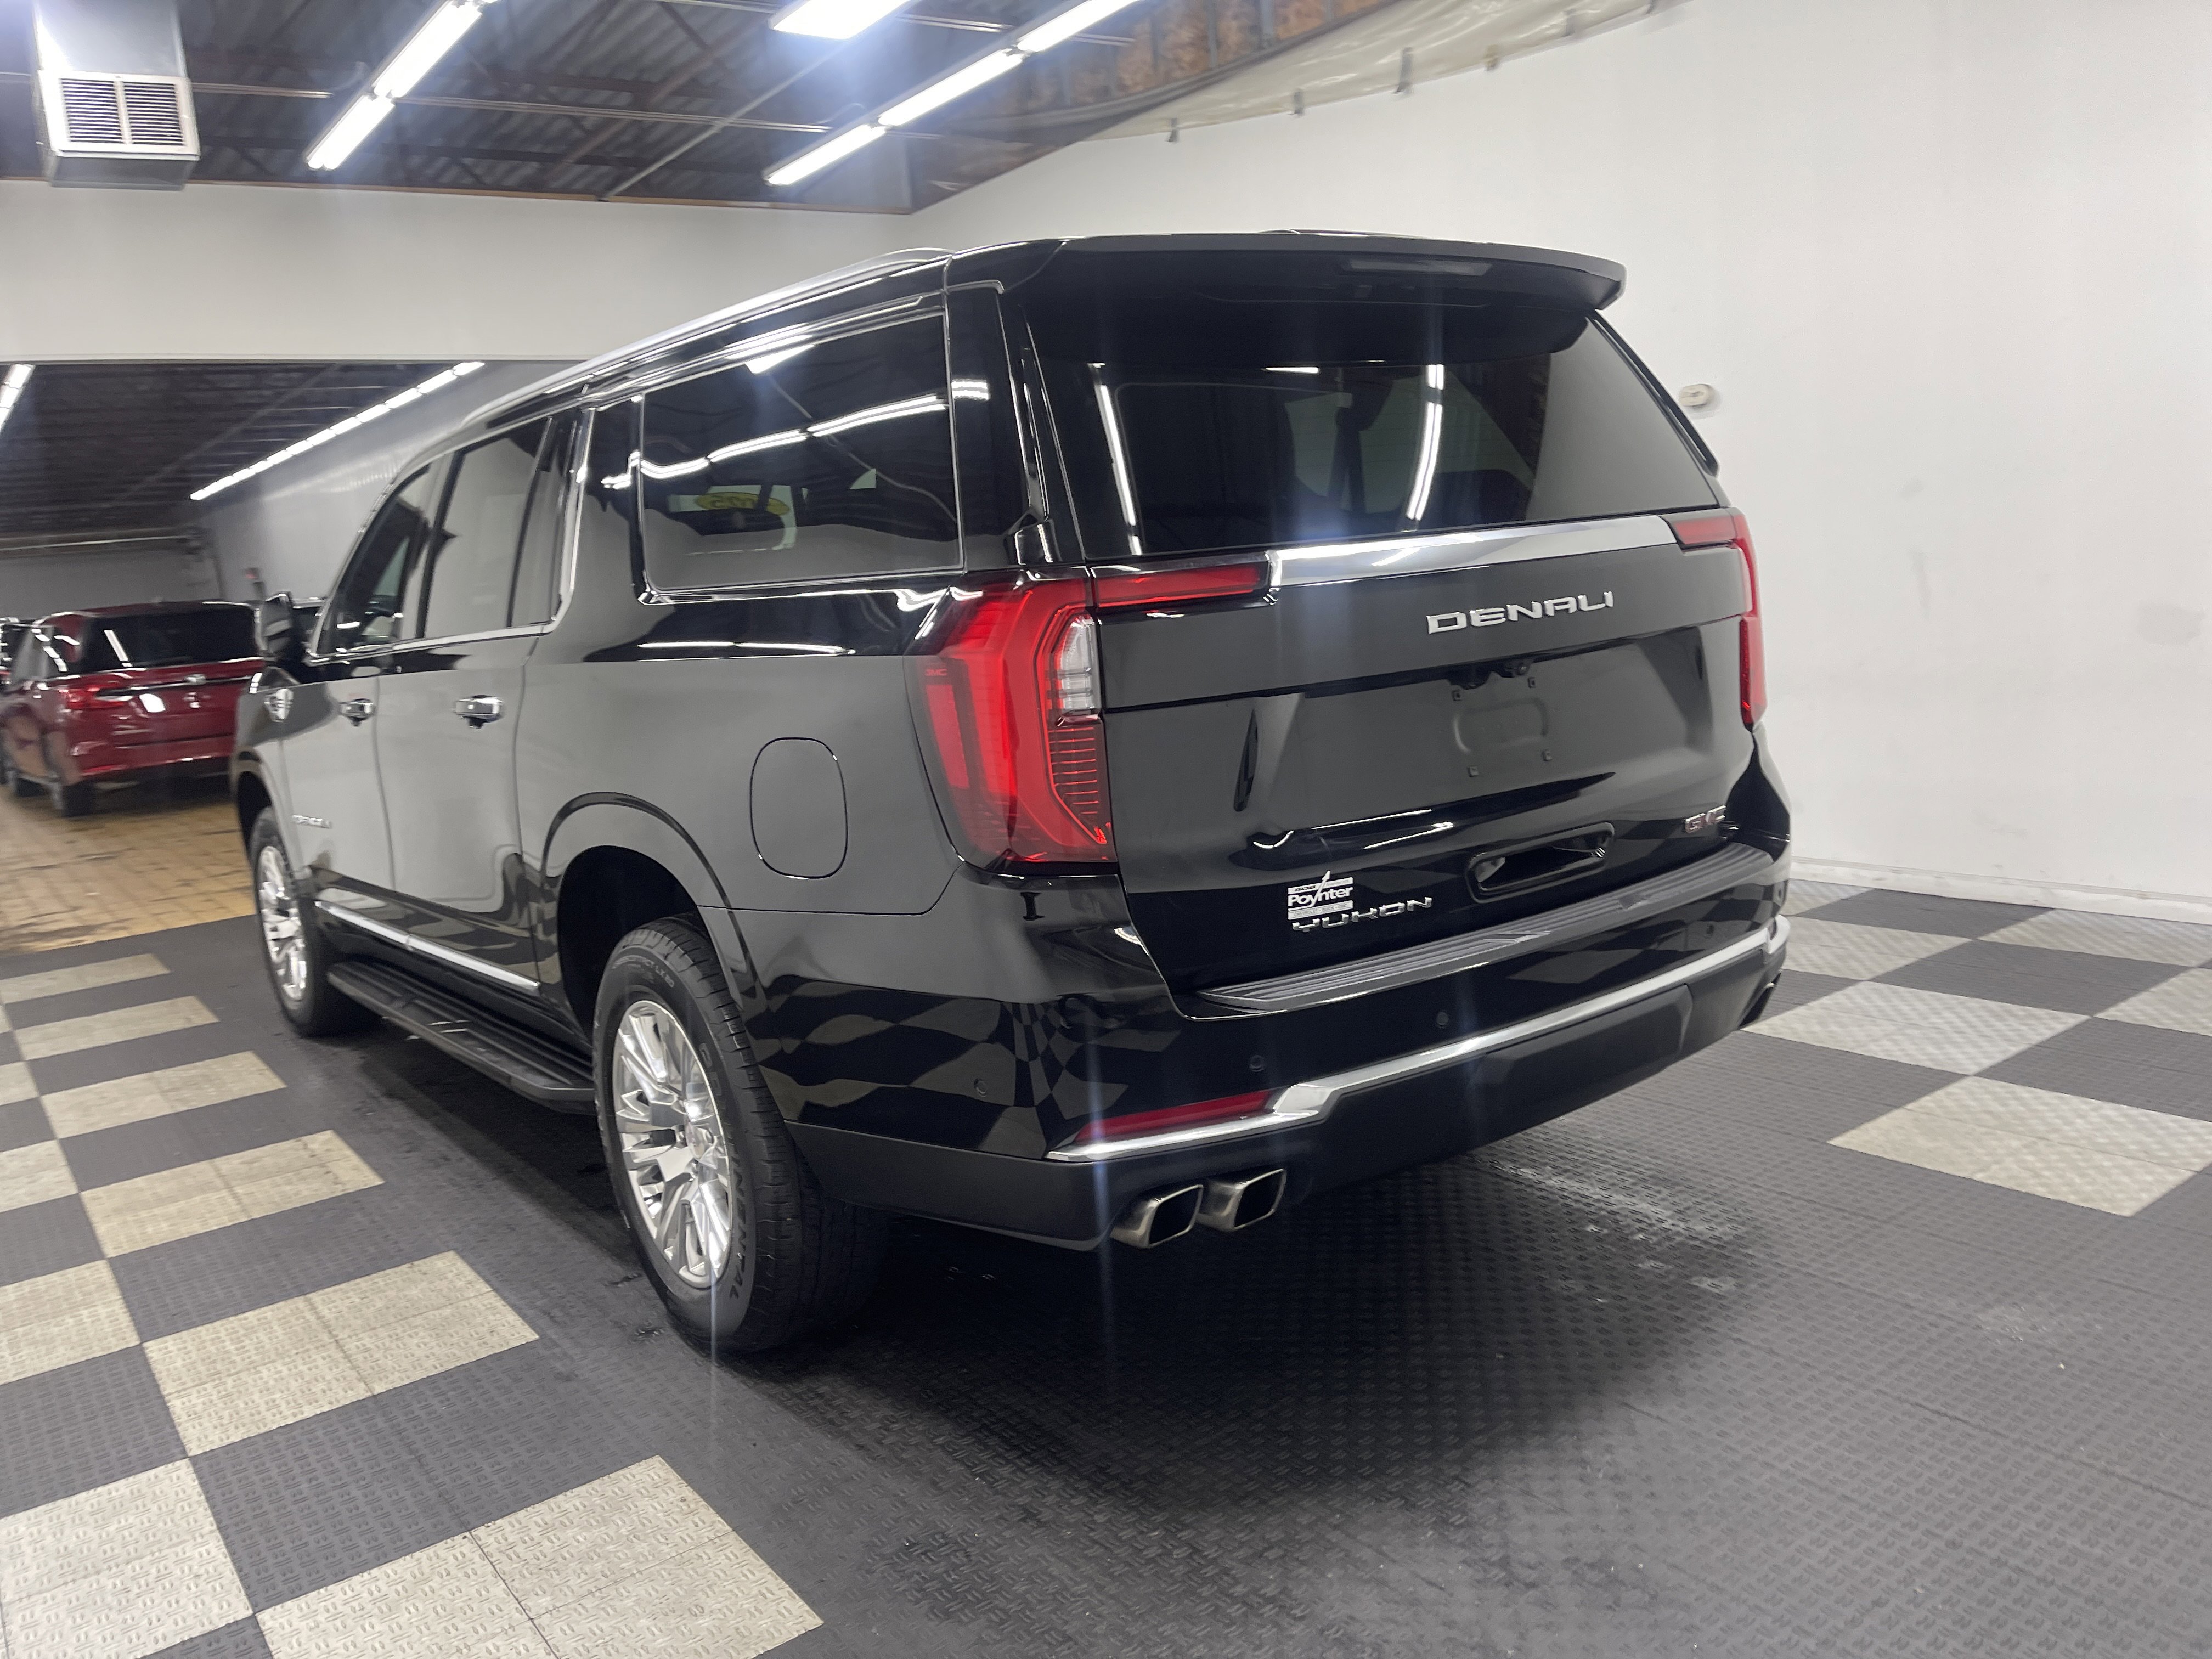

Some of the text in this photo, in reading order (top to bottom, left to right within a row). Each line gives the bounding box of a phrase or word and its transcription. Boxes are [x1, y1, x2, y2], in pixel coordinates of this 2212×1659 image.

[1426, 590, 1614, 634] DENALI
[1288, 887, 1354, 907] Poynter
[1292, 896, 1432, 933] YUKON
[698, 1042, 747, 1300] COINENTAL
